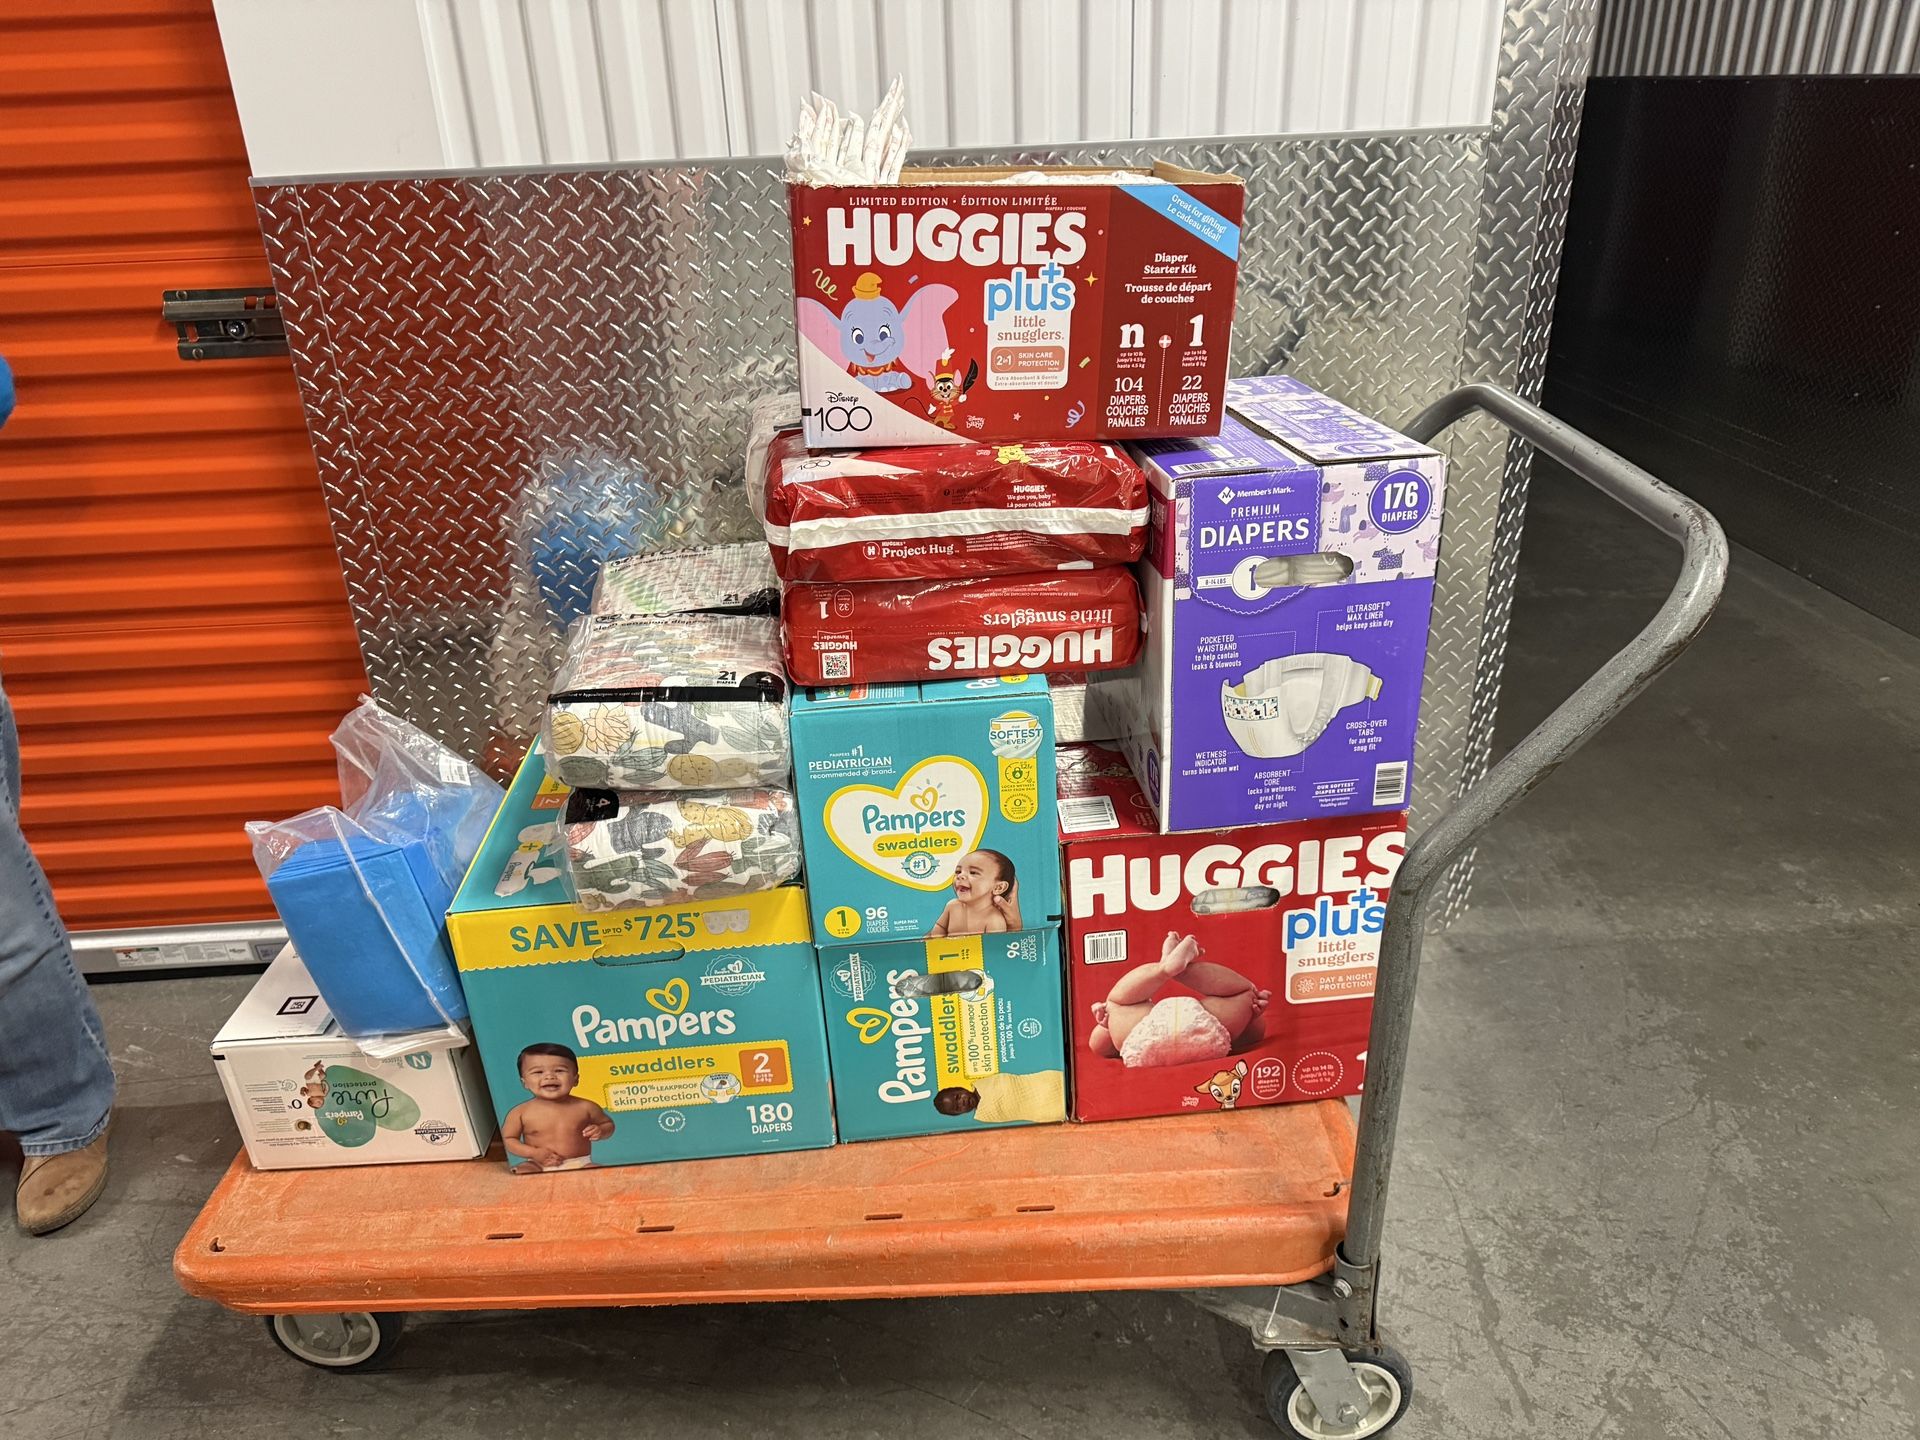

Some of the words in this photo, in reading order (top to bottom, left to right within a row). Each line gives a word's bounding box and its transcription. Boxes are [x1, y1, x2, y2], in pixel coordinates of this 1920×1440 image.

[849, 197, 897, 206] LIMITED
[901, 197, 949, 206] EDITION
[961, 194, 1008, 206] ÉDITION
[1012, 194, 1058, 206] LIMITÉE
[1171, 194, 1193, 212] Great
[1192, 206, 1203, 218] for
[1166, 203, 1177, 214] Le
[1175, 210, 1202, 230] cadeau
[827, 208, 1087, 266] HUGGIES
[1154, 253, 1188, 264] Diaper
[1143, 265, 1180, 274] Starter
[1181, 264, 1197, 274] Kit
[1125, 283, 1164, 293] Trousse
[1165, 282, 1178, 292] de
[1179, 282, 1212, 293] départ
[988, 271, 1071, 320] plus
[1141, 295, 1154, 304] de
[1155, 294, 1195, 303] couches
[1013, 315, 1046, 327] little
[1189, 314, 1203, 347] 1
[1115, 377, 1143, 392] 104
[1182, 375, 1202, 390] 22
[1110, 395, 1146, 405] DIAPERS
[1173, 393, 1208, 403] DIAPERS
[1106, 405, 1149, 416] COUCHES
[1168, 403, 1210, 414] COUCHES
[814, 406, 872, 432] 100
[1107, 414, 1145, 427] PAÑALES
[1169, 413, 1207, 425] PAÑALES
[1013, 485, 1046, 493] HUGGIES
[1237, 488, 1272, 498] Member's
[1272, 486, 1291, 494] Mark
[1384, 481, 1419, 510] 176
[1231, 504, 1280, 518] PREMIUM
[1381, 510, 1419, 522] DIAPERS
[1200, 518, 1309, 549] DIAPERS
[882, 546, 928, 560] Project
[929, 543, 954, 555] Hug
[724, 594, 739, 602] 21
[819, 601, 830, 619] 1
[839, 602, 850, 611] 32
[1070, 608, 1113, 626] little
[1347, 612, 1362, 621] MAX
[1364, 611, 1384, 620] LINER
[1336, 623, 1352, 631] helps
[1353, 622, 1366, 630] keep
[1366, 620, 1380, 628] skin
[1381, 619, 1394, 628] dry
[1200, 634, 1235, 644] POCKETED
[811, 640, 858, 651] HUGGIES
[927, 627, 1114, 671] HUGGIES
[1197, 643, 1237, 653] WAISTBAND
[1203, 653, 1216, 662] help
[1217, 651, 1239, 660] contain
[1191, 662, 1208, 671] leaks
[1215, 660, 1242, 668] blowouts
[718, 671, 736, 680] 21
[1346, 719, 1388, 730] CROSS-OVER
[990, 729, 1042, 740] SOFTEST
[1358, 728, 1375, 737] TABS
[851, 745, 863, 757] #1
[1195, 750, 1227, 759] WETNESS
[808, 756, 892, 771] PEDIATRICIAN
[1194, 758, 1227, 767] INDICATOR
[810, 770, 861, 780] recommended
[1199, 766, 1211, 775] blue
[1213, 765, 1227, 773] when
[1254, 769, 1291, 780] ABSORBENT
[1264, 778, 1280, 786] CORE
[1247, 787, 1263, 795] locks
[1275, 793, 1284, 801] for
[1254, 802, 1265, 810] day
[1273, 801, 1288, 809] night
[862, 804, 966, 834] Pampers
[877, 837, 958, 852] swaddlers
[1070, 831, 1406, 919] HUGGIES
[837, 910, 846, 927] 1
[865, 906, 888, 920] 96
[866, 919, 889, 927] DIAPERS
[1287, 900, 1387, 949] plus
[867, 926, 889, 934] COUCHES
[509, 920, 600, 953] SAVE
[1007, 941, 1020, 958] 96
[1021, 938, 1029, 960] DIAPERS
[1028, 935, 1037, 962] COUCHES
[1317, 939, 1357, 953] little
[940, 953, 960, 961] 1
[1297, 951, 1375, 968] snugglers
[704, 974, 762, 983] PEDIATRICIAN
[852, 956, 862, 999] PEDIATRICIAN
[1319, 976, 1336, 984] DAY
[1346, 972, 1373, 981] NIGHT
[1319, 979, 1373, 991] PROTECTION
[571, 1004, 736, 1048] Pampers
[968, 1004, 976, 1038] LEAKPROOF
[979, 1002, 992, 1051] protection
[998, 1022, 1005, 1030] de
[940, 993, 960, 1074] swaddler
[999, 1031, 1008, 1063] protection
[411, 1055, 426, 1068] N
[610, 1056, 716, 1076] swaddlers
[753, 1052, 771, 1074] 2
[981, 1053, 992, 1072] skin
[1256, 1065, 1281, 1079] 192
[332, 1080, 377, 1089] protection
[656, 1083, 698, 1091] LEAKPROOF
[331, 1089, 394, 1119] Pure
[614, 1095, 637, 1106] skin
[640, 1092, 700, 1106] protection
[325, 1109, 365, 1121] Pampers
[746, 1102, 793, 1124] 180
[752, 1122, 793, 1135] DIAPERS
